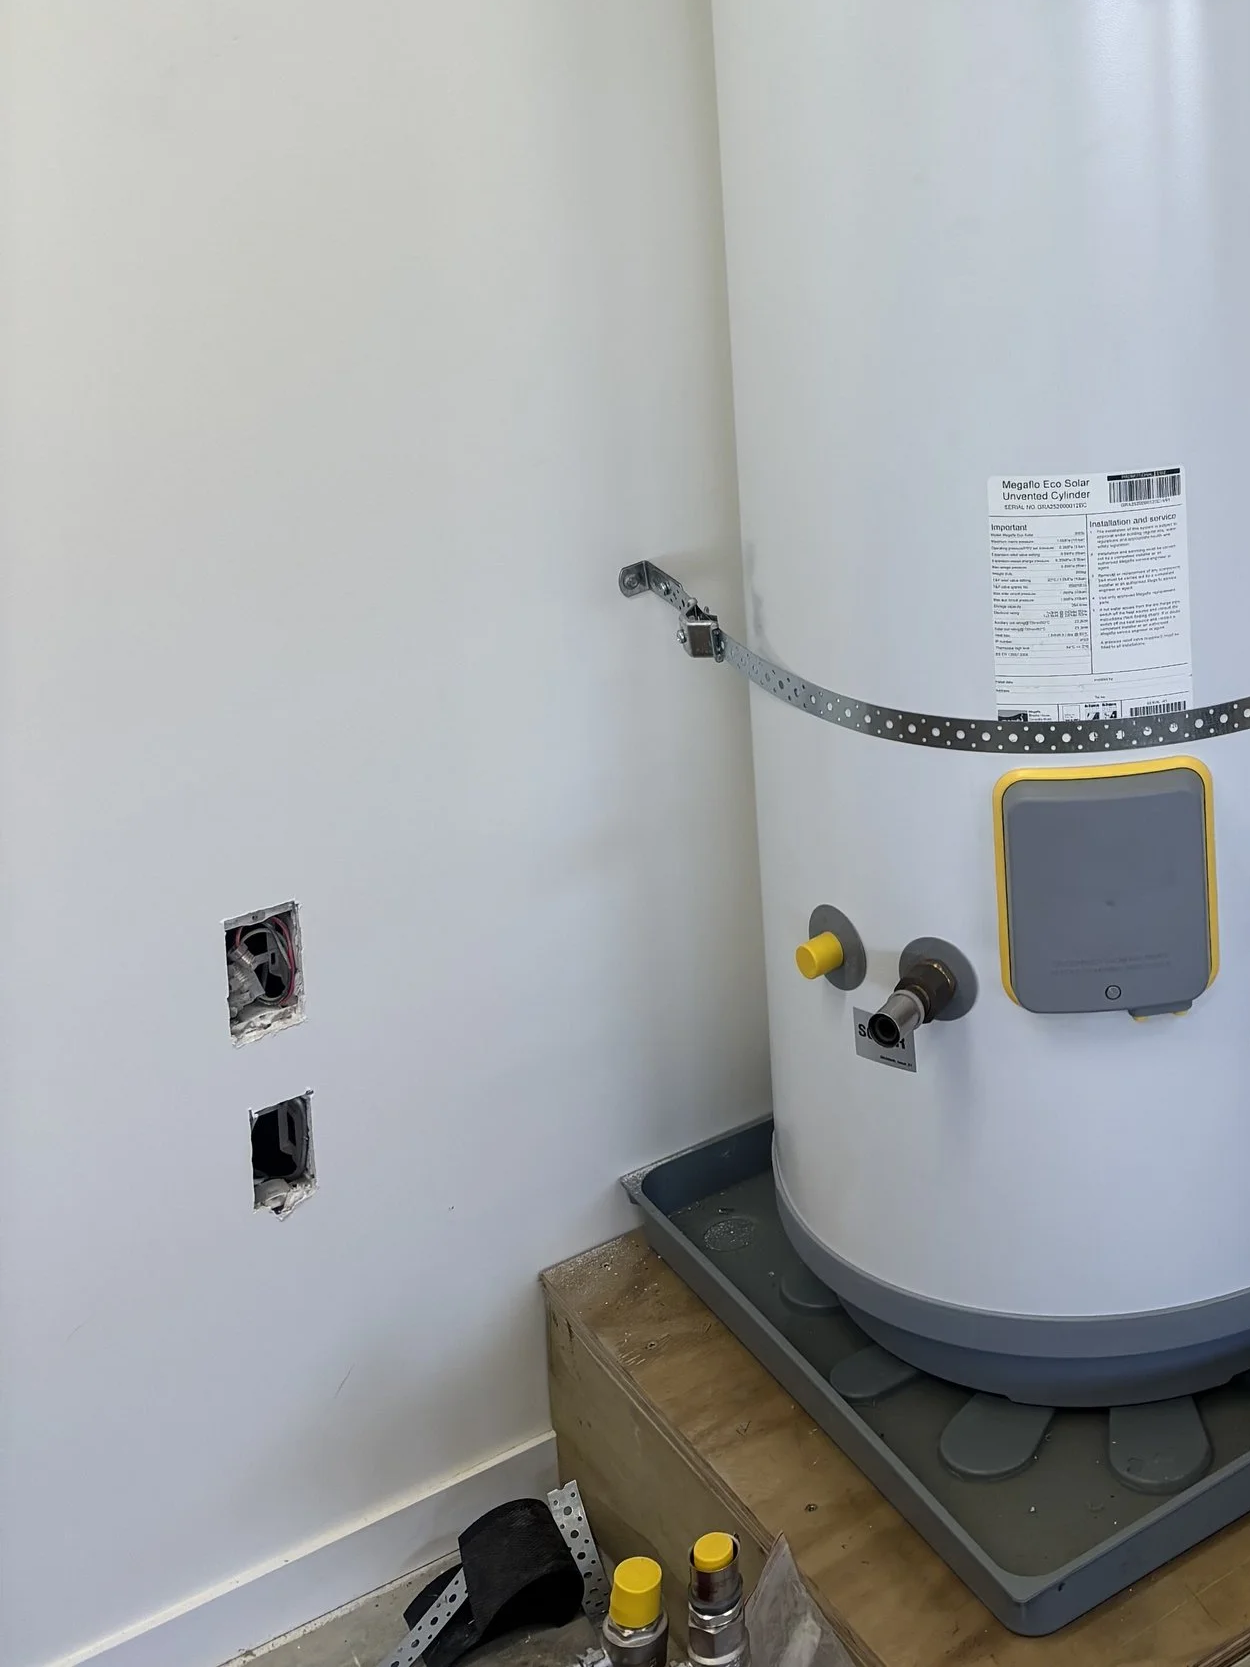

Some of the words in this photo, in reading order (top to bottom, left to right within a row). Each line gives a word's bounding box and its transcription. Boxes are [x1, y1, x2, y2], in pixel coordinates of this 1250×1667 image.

[1002, 480, 1041, 491] Megaflo
[1043, 480, 1062, 489] Eco
[1064, 479, 1090, 488] Solar
[1002, 491, 1048, 501] Unvented
[1051, 491, 1091, 501] Cylinder
[1089, 519, 1131, 528] Installation
[1133, 516, 1148, 524] and
[1149, 514, 1177, 522] service
[991, 524, 1028, 532] Important
